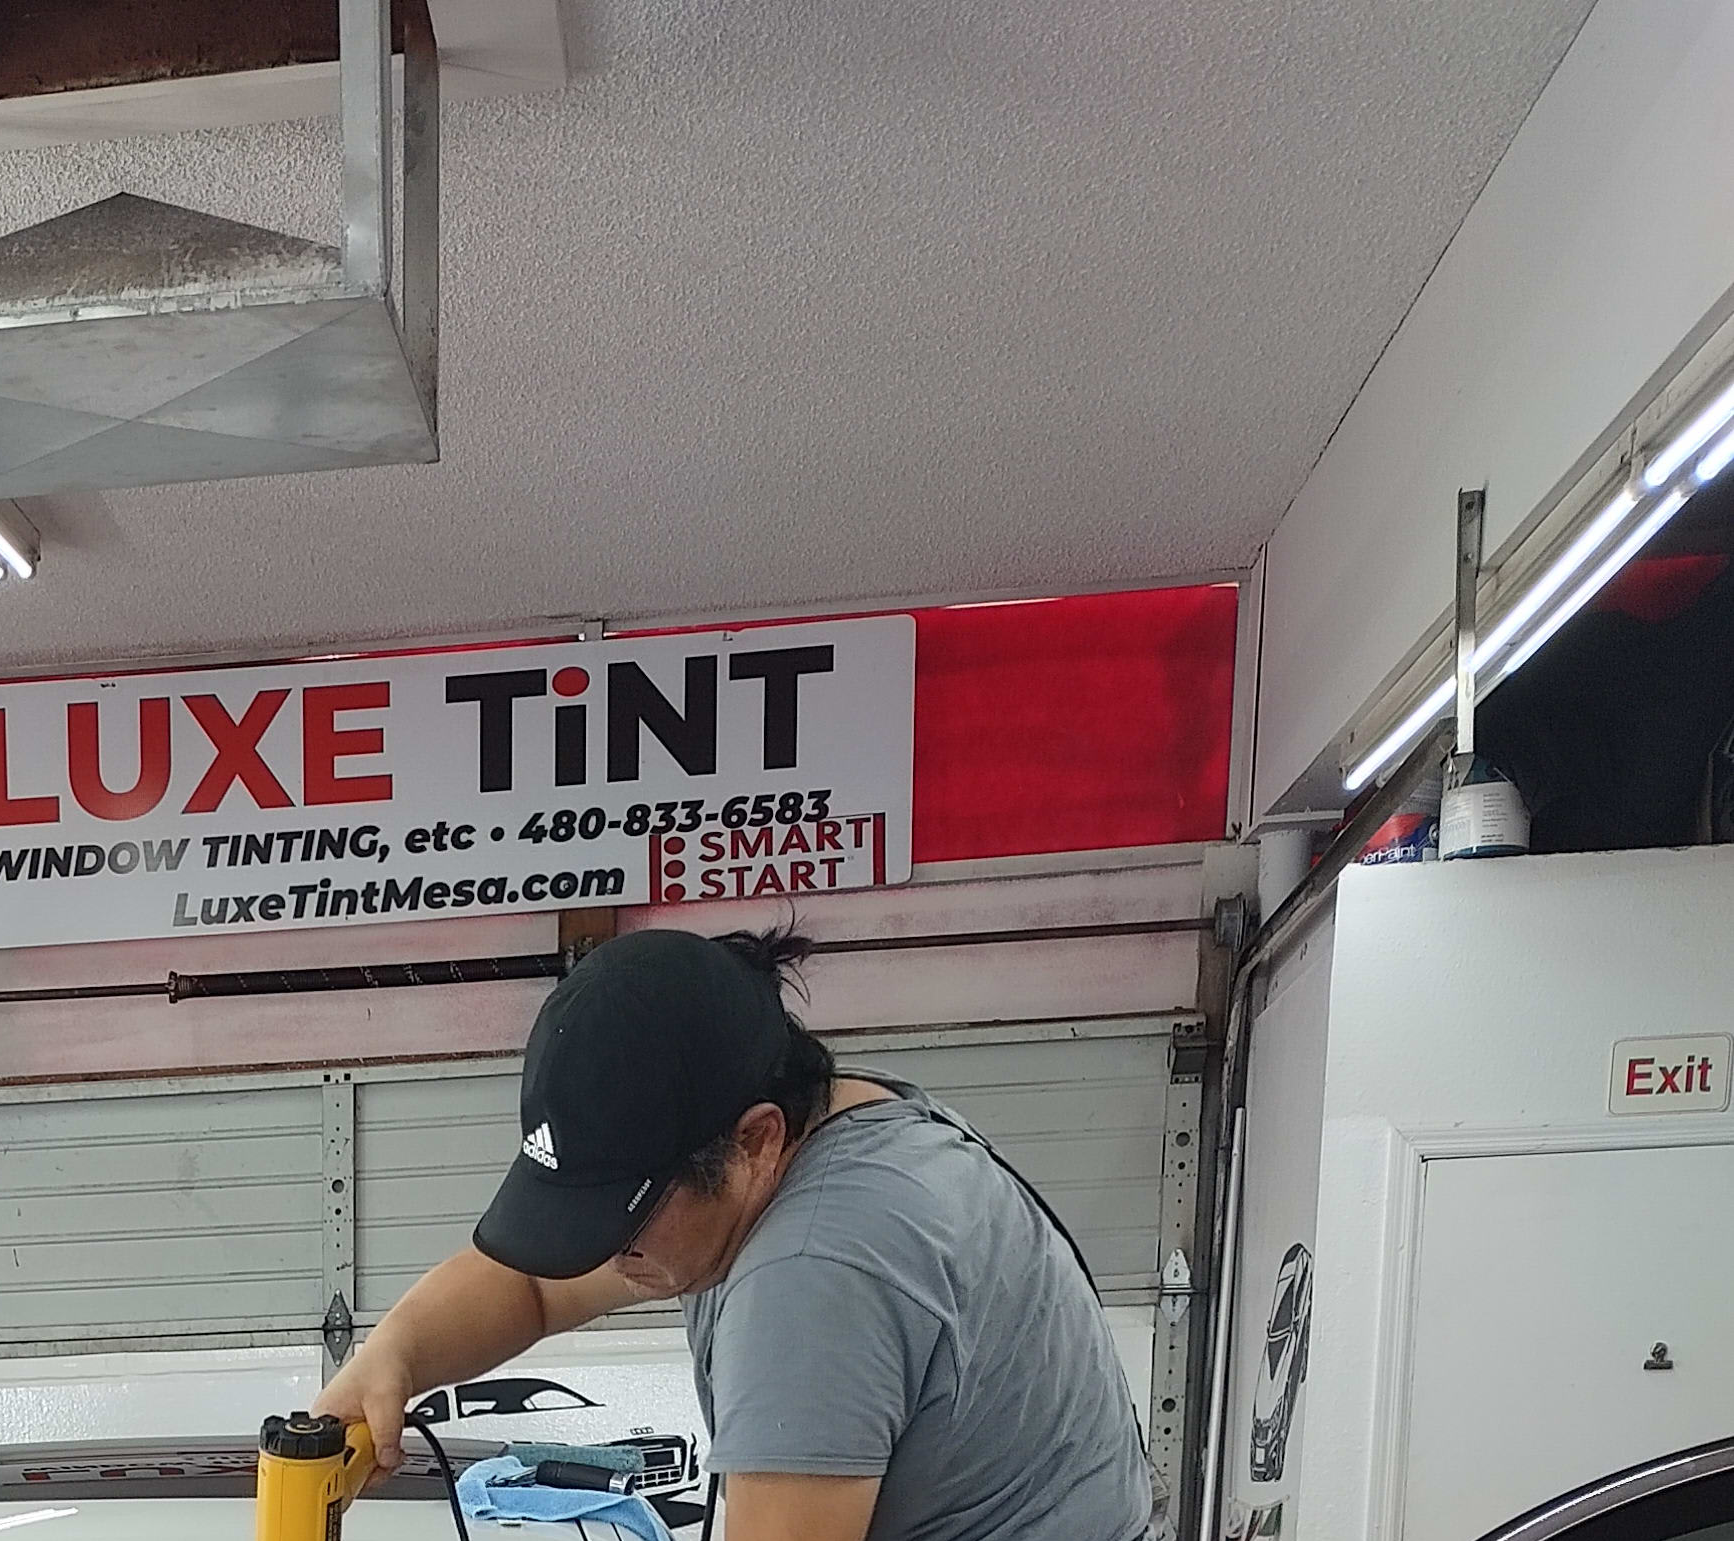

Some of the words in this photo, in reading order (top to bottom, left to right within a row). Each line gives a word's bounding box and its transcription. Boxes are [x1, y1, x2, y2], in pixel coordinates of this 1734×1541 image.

[202, 825, 391, 868] TINTING,
[404, 820, 475, 855] etc
[518, 789, 833, 846] 480-833-6583
[698, 816, 872, 863] SMART
[172, 867, 626, 928] LuxeTintMesa.com
[698, 856, 845, 899] START
[1625, 1054, 1713, 1096] Exit
[522, 1139, 559, 1170] adidas
